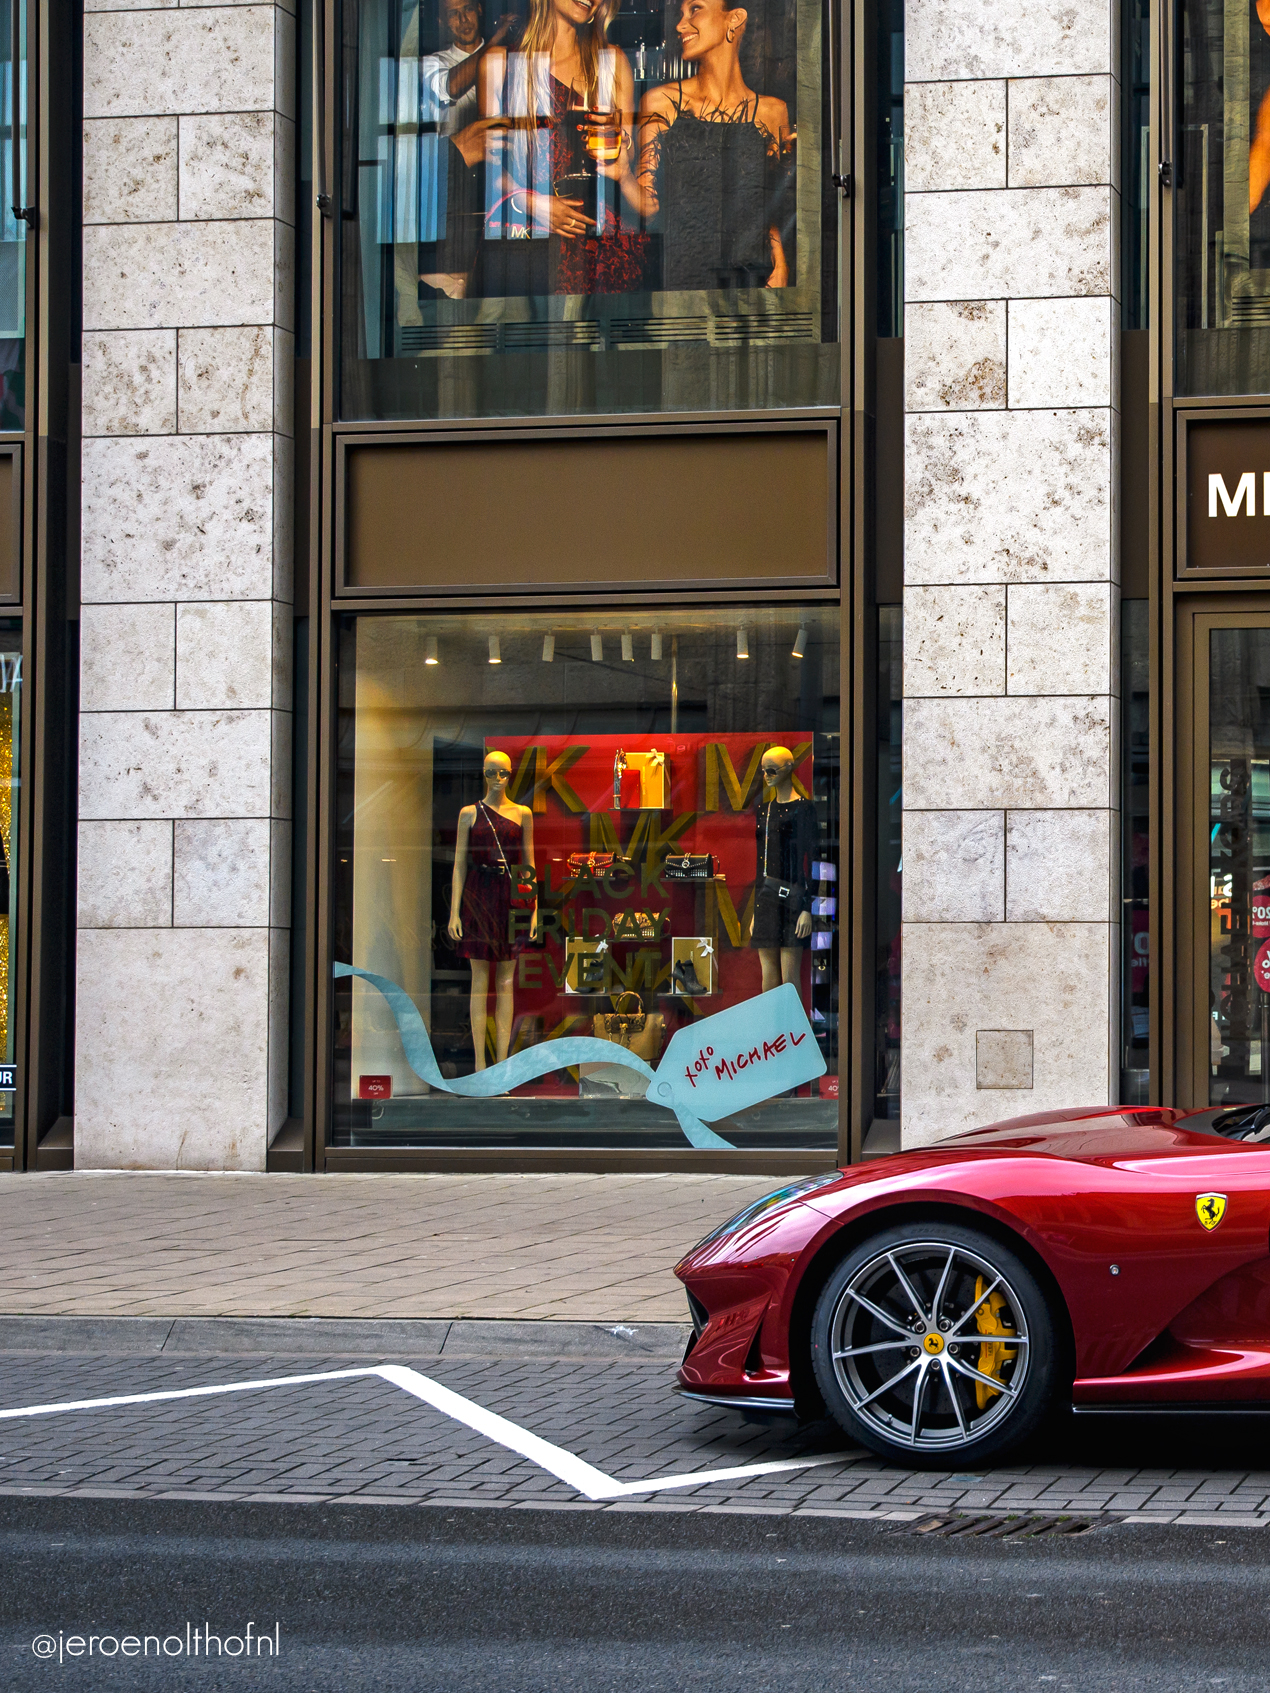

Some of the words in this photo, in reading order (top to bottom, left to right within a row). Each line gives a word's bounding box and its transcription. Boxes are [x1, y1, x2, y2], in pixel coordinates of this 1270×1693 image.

[511, 225, 530, 239] MK
[511, 863, 671, 899] BLACK
[508, 907, 672, 944] FRIDAY
[519, 952, 662, 989] EVENT
[714, 1031, 806, 1081] MICHAEL
[0, 1071, 13, 1084] R
